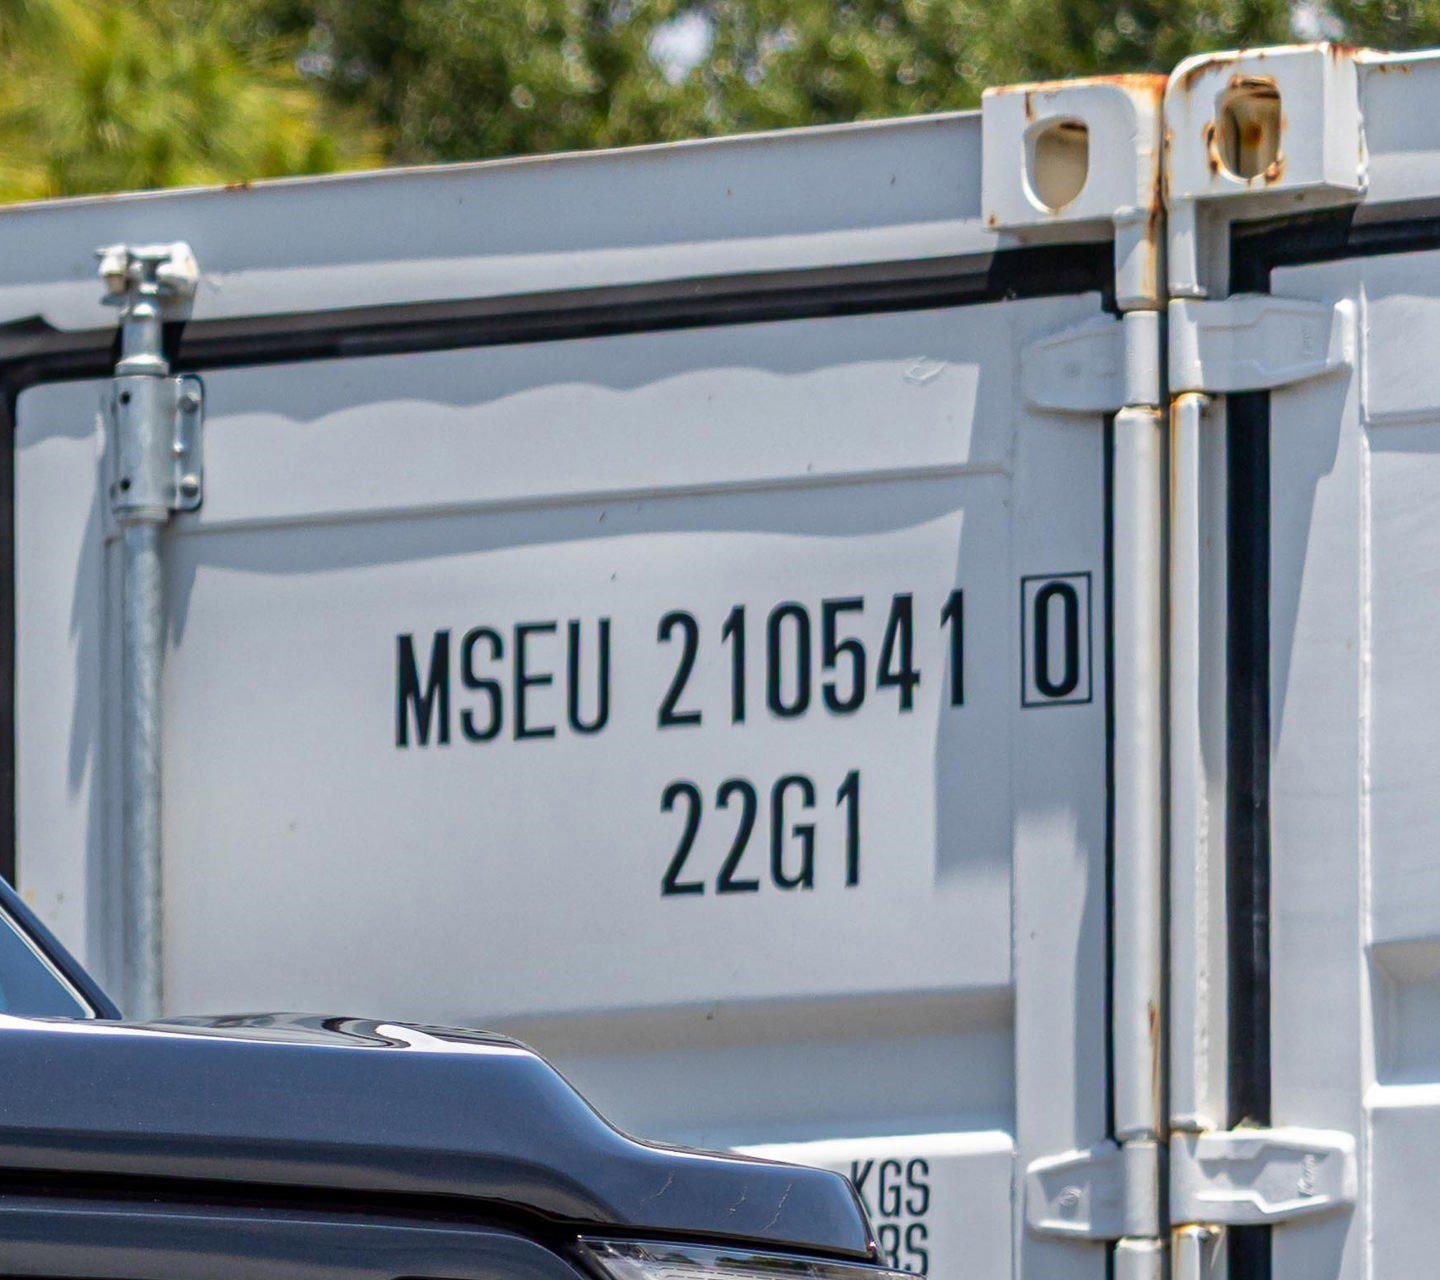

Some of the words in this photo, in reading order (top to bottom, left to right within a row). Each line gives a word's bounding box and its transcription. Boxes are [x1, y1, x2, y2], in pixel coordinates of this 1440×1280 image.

[395, 616, 611, 748] MSEU
[656, 588, 966, 730] 210541
[659, 769, 862, 898] 22G1
[851, 1158, 930, 1217] KGS
